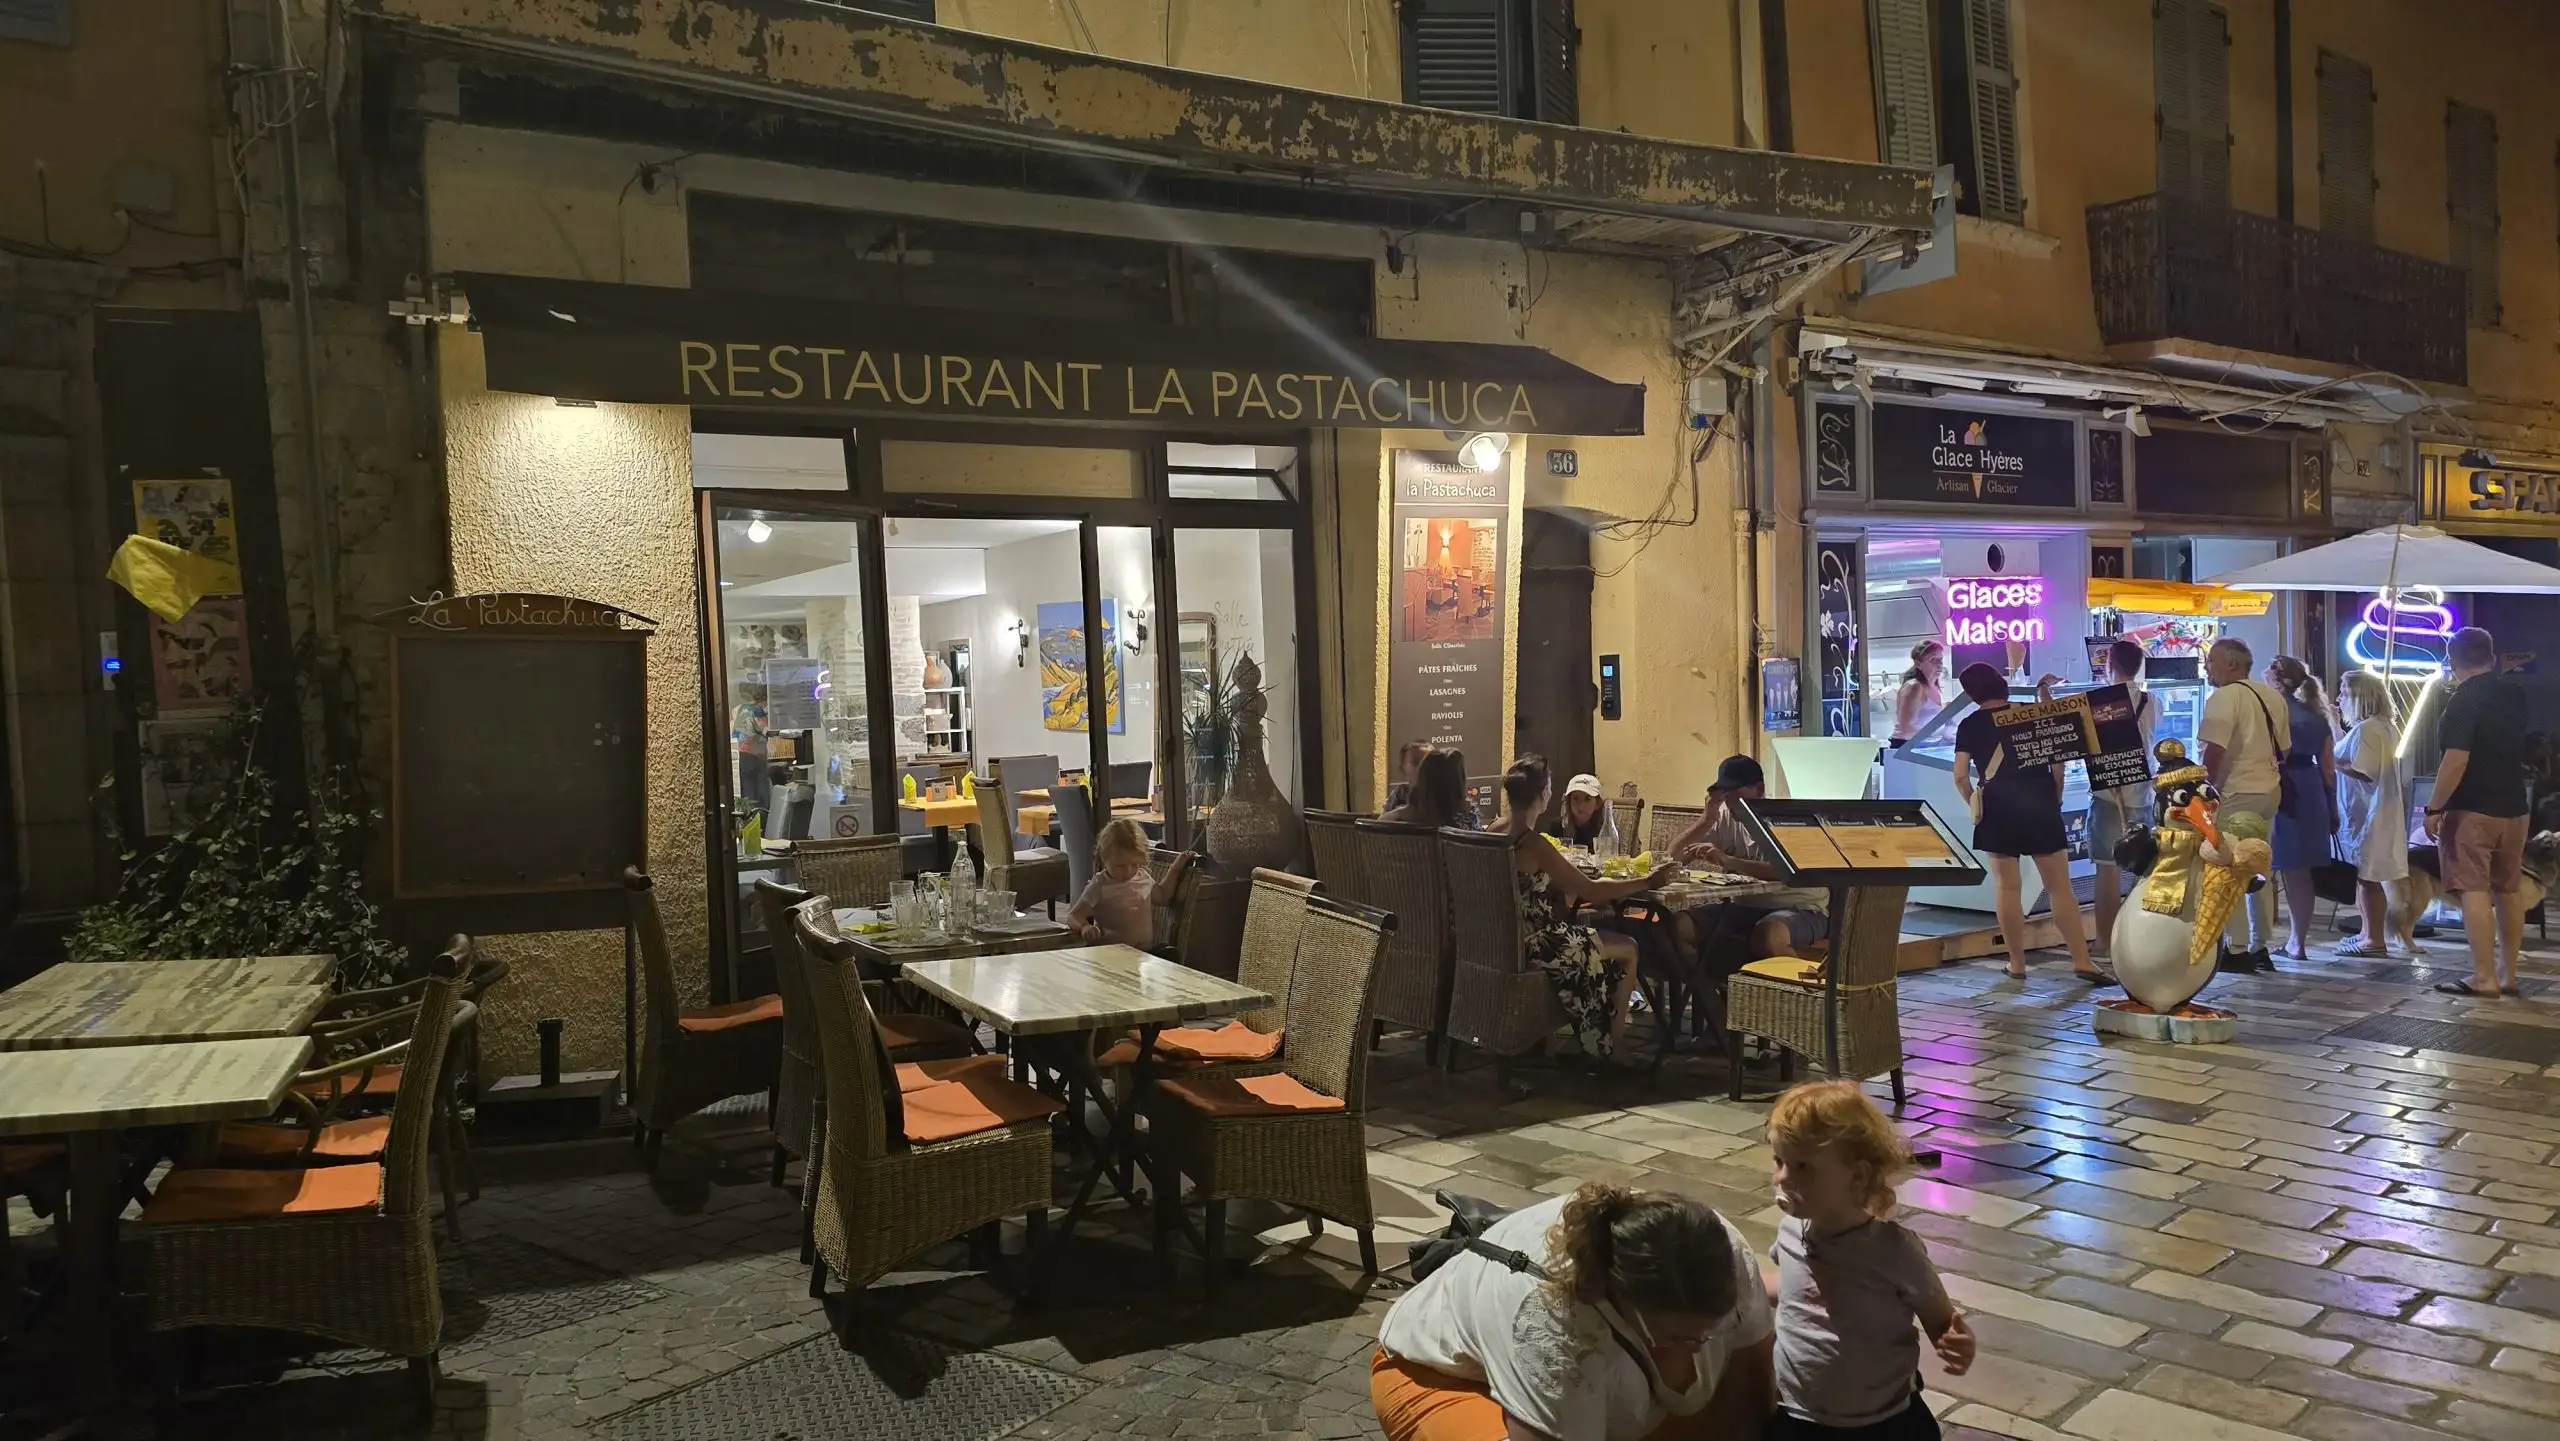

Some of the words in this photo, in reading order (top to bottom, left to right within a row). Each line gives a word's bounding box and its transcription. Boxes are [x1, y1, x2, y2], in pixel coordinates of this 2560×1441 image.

[679, 341, 1103, 411] RESTAURANT
[1127, 367, 1193, 417] LA
[1212, 371, 1539, 427] PASTACHUCA
[1939, 424, 1956, 445] La
[1553, 452, 1574, 473] 36
[1932, 446, 1973, 468] Glace
[1980, 449, 2024, 474] Hyères
[1406, 477, 1418, 497] la
[1423, 478, 1496, 498] Pastachuca
[1936, 477, 1969, 492] Artisan
[1987, 479, 2019, 494] Glacier
[2469, 470, 2560, 514] SPA
[1946, 581, 2044, 610] Glaces
[408, 590, 468, 631] La
[466, 589, 630, 627] Pastachuca
[1945, 614, 2045, 646] Maison
[1418, 665, 1441, 674] PÂTES
[1442, 662, 1478, 673] FRAÎCHES
[1429, 687, 1466, 697] LASAGNES
[1431, 711, 1464, 720] RAVIOLIS
[1996, 709, 2036, 726] GLACE
[2038, 696, 2088, 717] MAISON
[2033, 717, 2056, 729] ICI
[1431, 735, 1463, 744] POLENTA
[2011, 731, 2033, 742] NOUS
[2053, 732, 2079, 745] GLACES
[2092, 748, 2145, 766] HAUSGEMACHTE
[2095, 770, 2120, 782] HOME
[2120, 766, 2143, 777] MADE
[2107, 777, 2120, 787] ICE
[2123, 773, 2148, 783] CREAM
